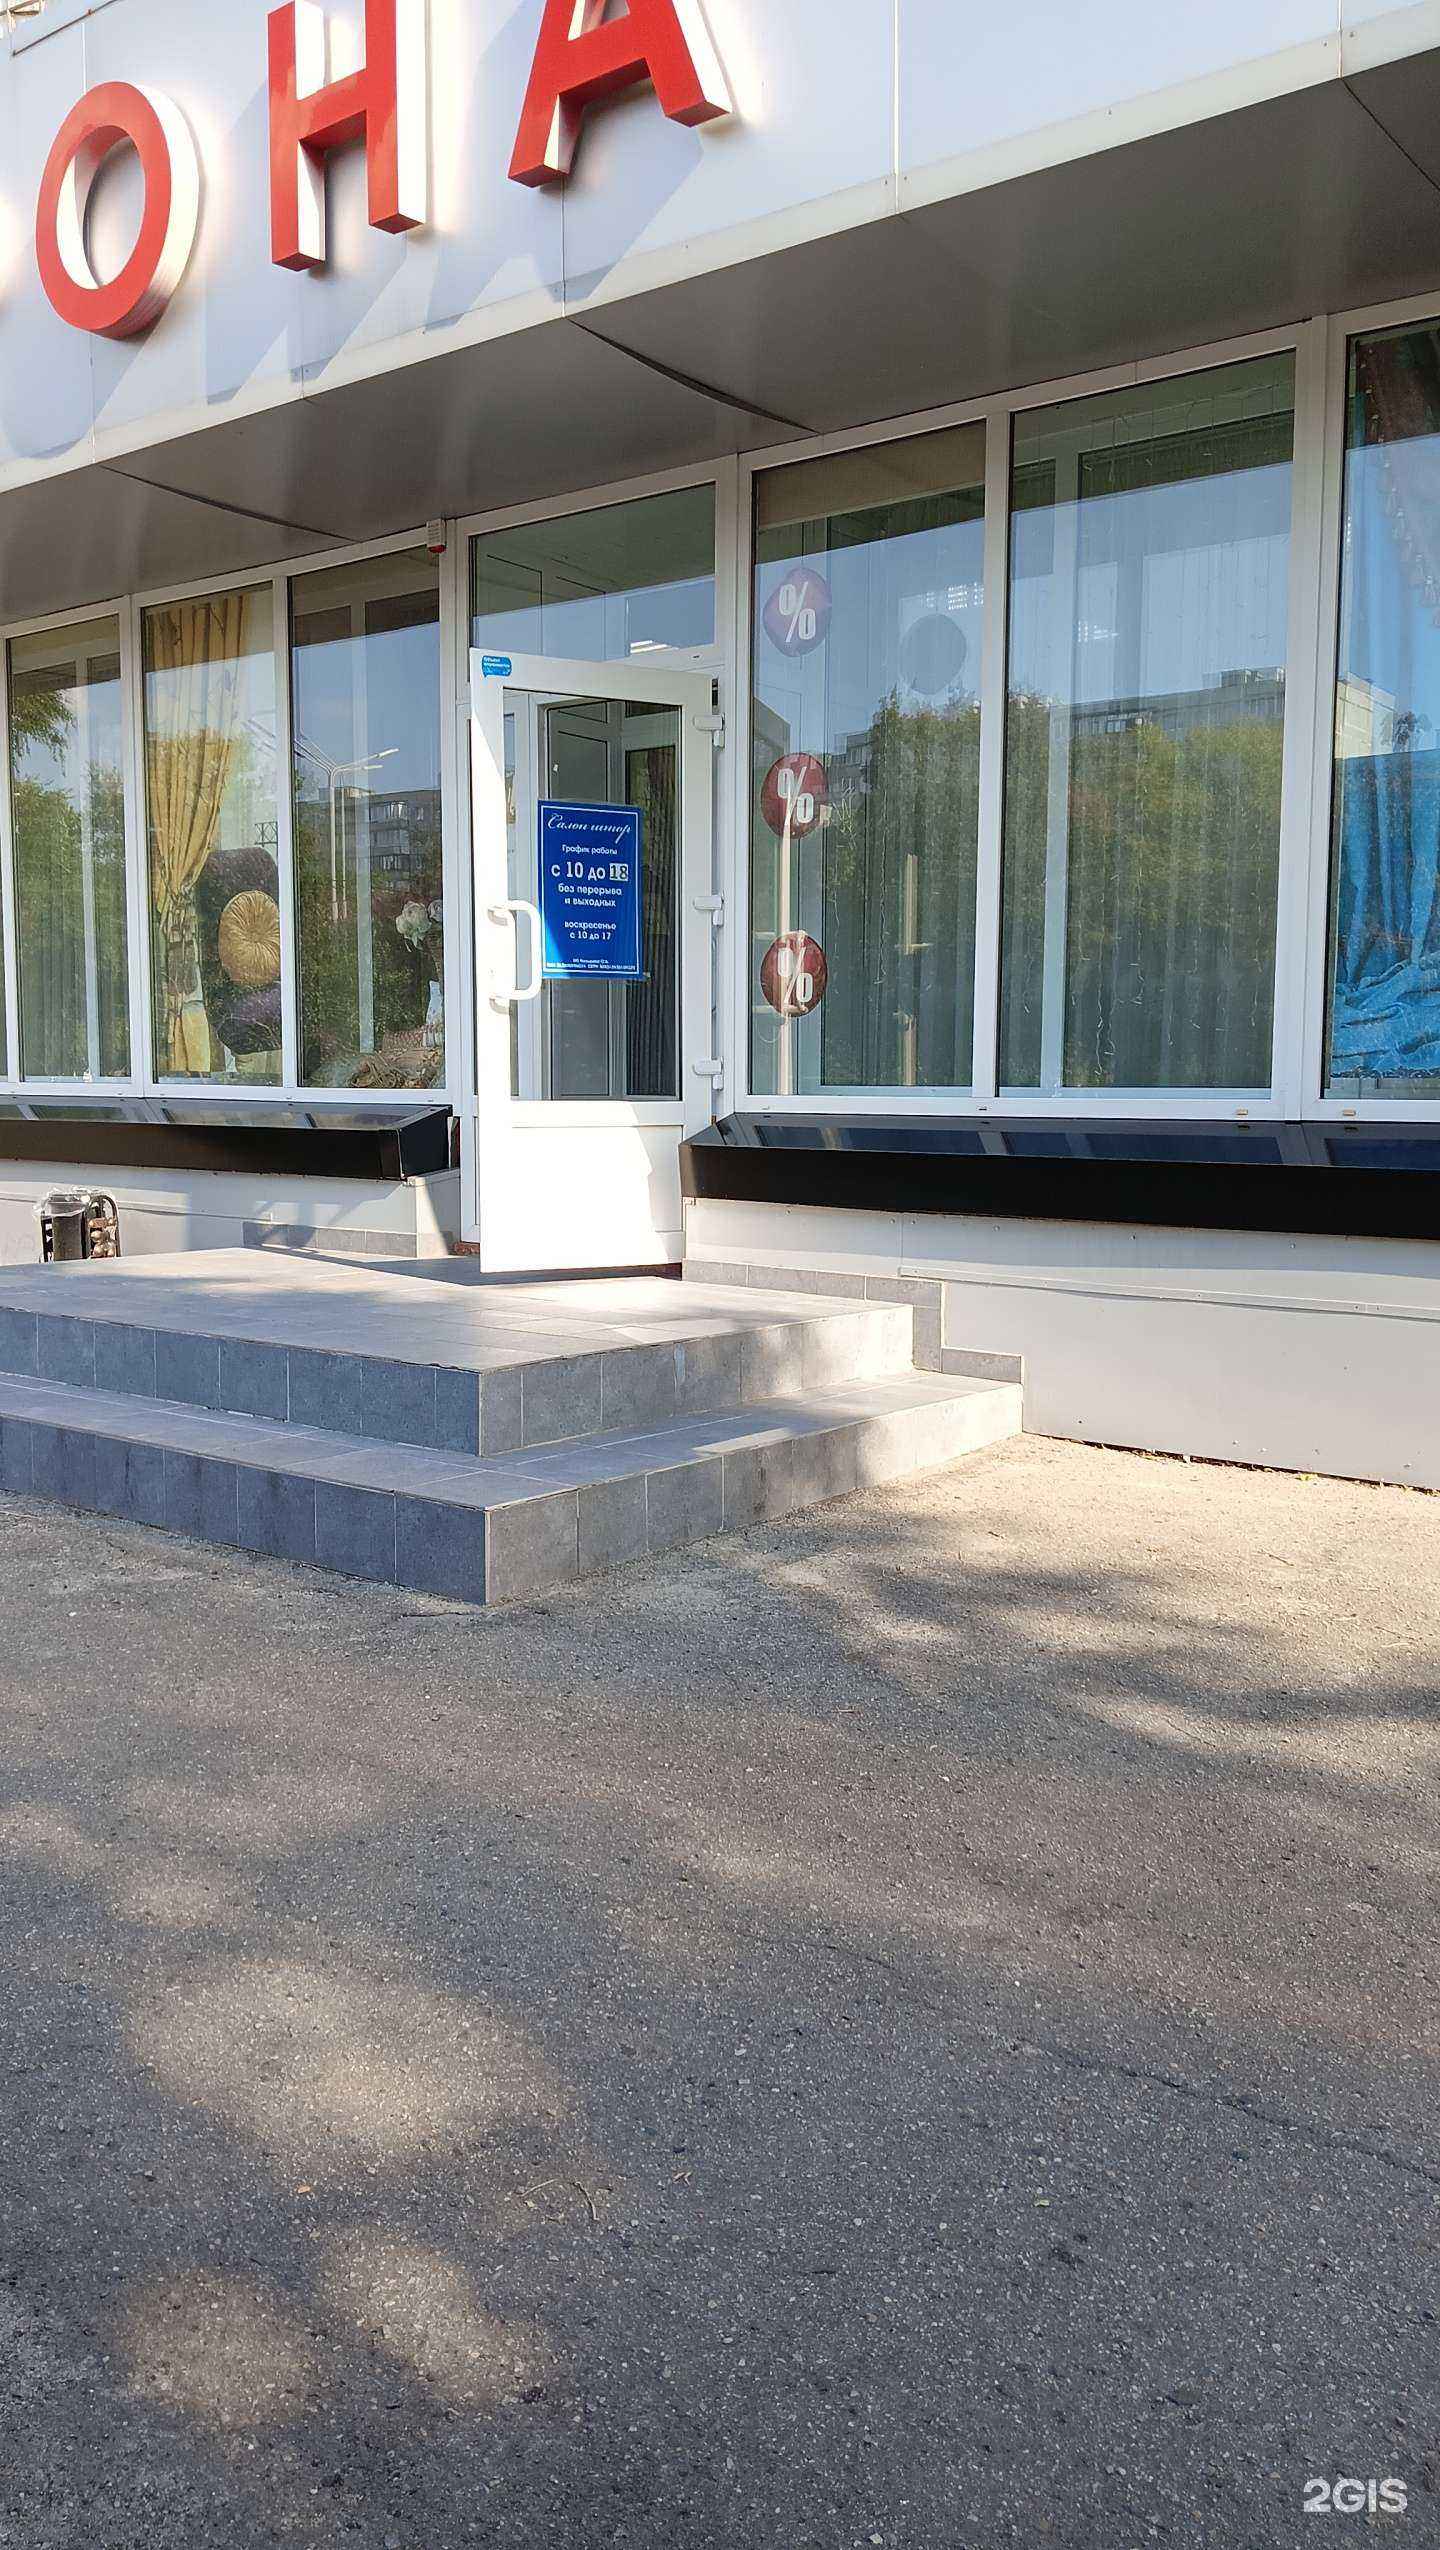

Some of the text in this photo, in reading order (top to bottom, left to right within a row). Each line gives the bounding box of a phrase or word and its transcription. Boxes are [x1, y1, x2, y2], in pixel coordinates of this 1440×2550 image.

[779, 582, 816, 643] %
[777, 766, 814, 825] %
[548, 813, 631, 844] Салон штор
[562, 844, 618, 855] График работы
[566, 861, 584, 878] 10
[587, 867, 606, 881] до
[610, 864, 628, 881] 18
[558, 883, 622, 896] без перерыва
[573, 898, 616, 907] выходных
[564, 921, 617, 930] воскресенье
[577, 931, 588, 939] 10
[602, 932, 611, 940] 17
[777, 946, 814, 1006] %
